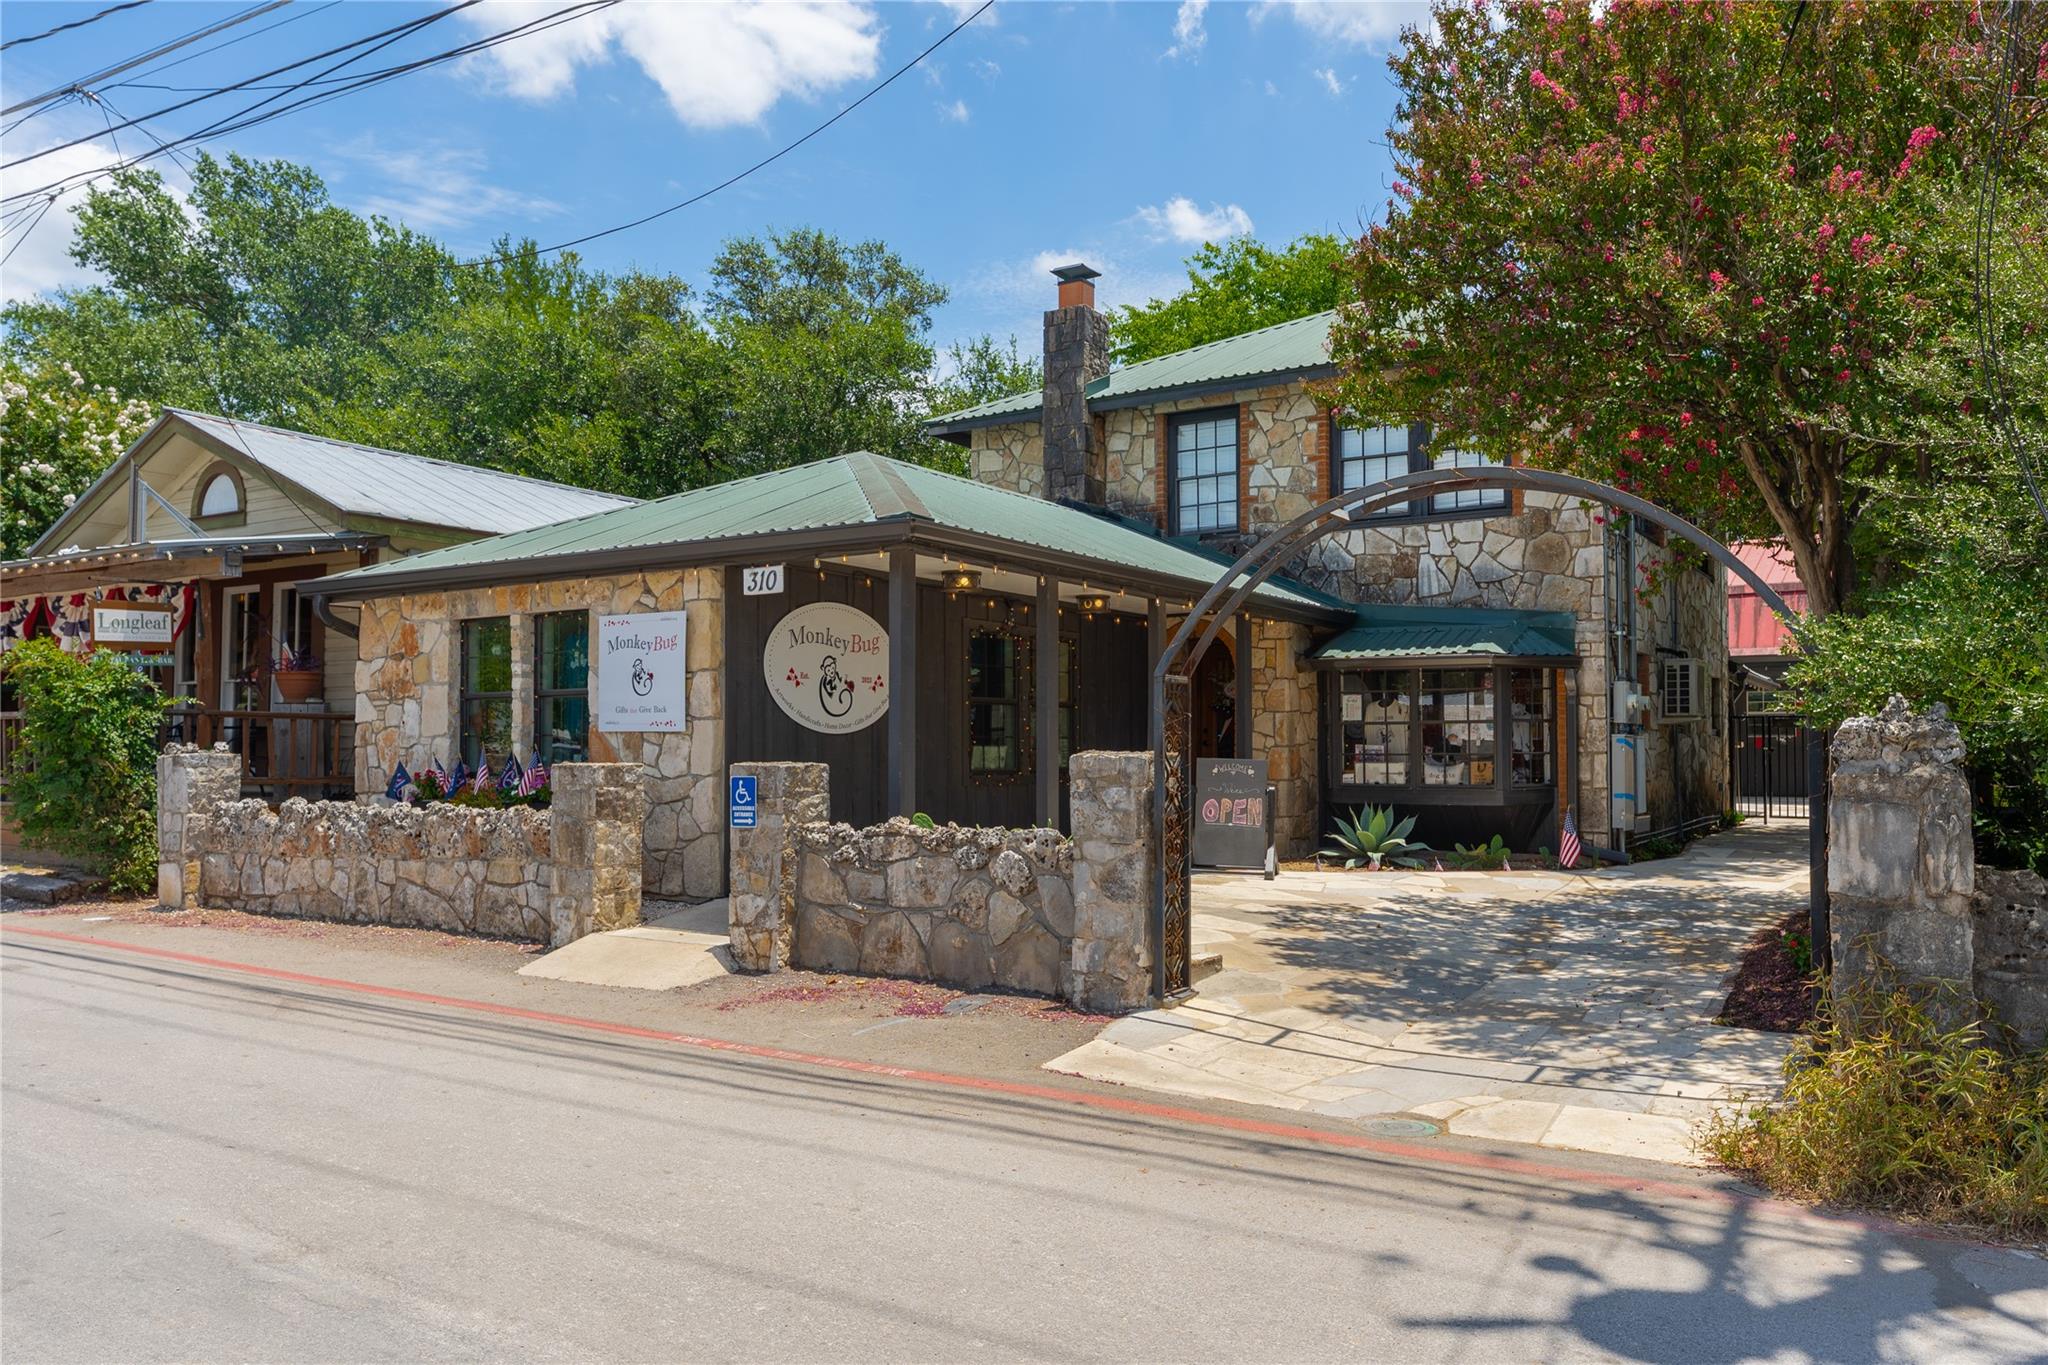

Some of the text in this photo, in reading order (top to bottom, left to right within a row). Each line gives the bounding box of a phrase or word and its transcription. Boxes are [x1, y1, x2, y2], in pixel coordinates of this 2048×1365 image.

[747, 570, 777, 592] 310
[97, 612, 169, 634] Longleaf
[607, 633, 679, 655] MonkeyBug
[788, 625, 880, 656] MonkeyBug
[615, 705, 628, 714] Gifts
[639, 705, 652, 713] Give
[654, 704, 667, 713] Back
[1216, 763, 1247, 775] WELCOME
[1202, 797, 1263, 826] OPEN
